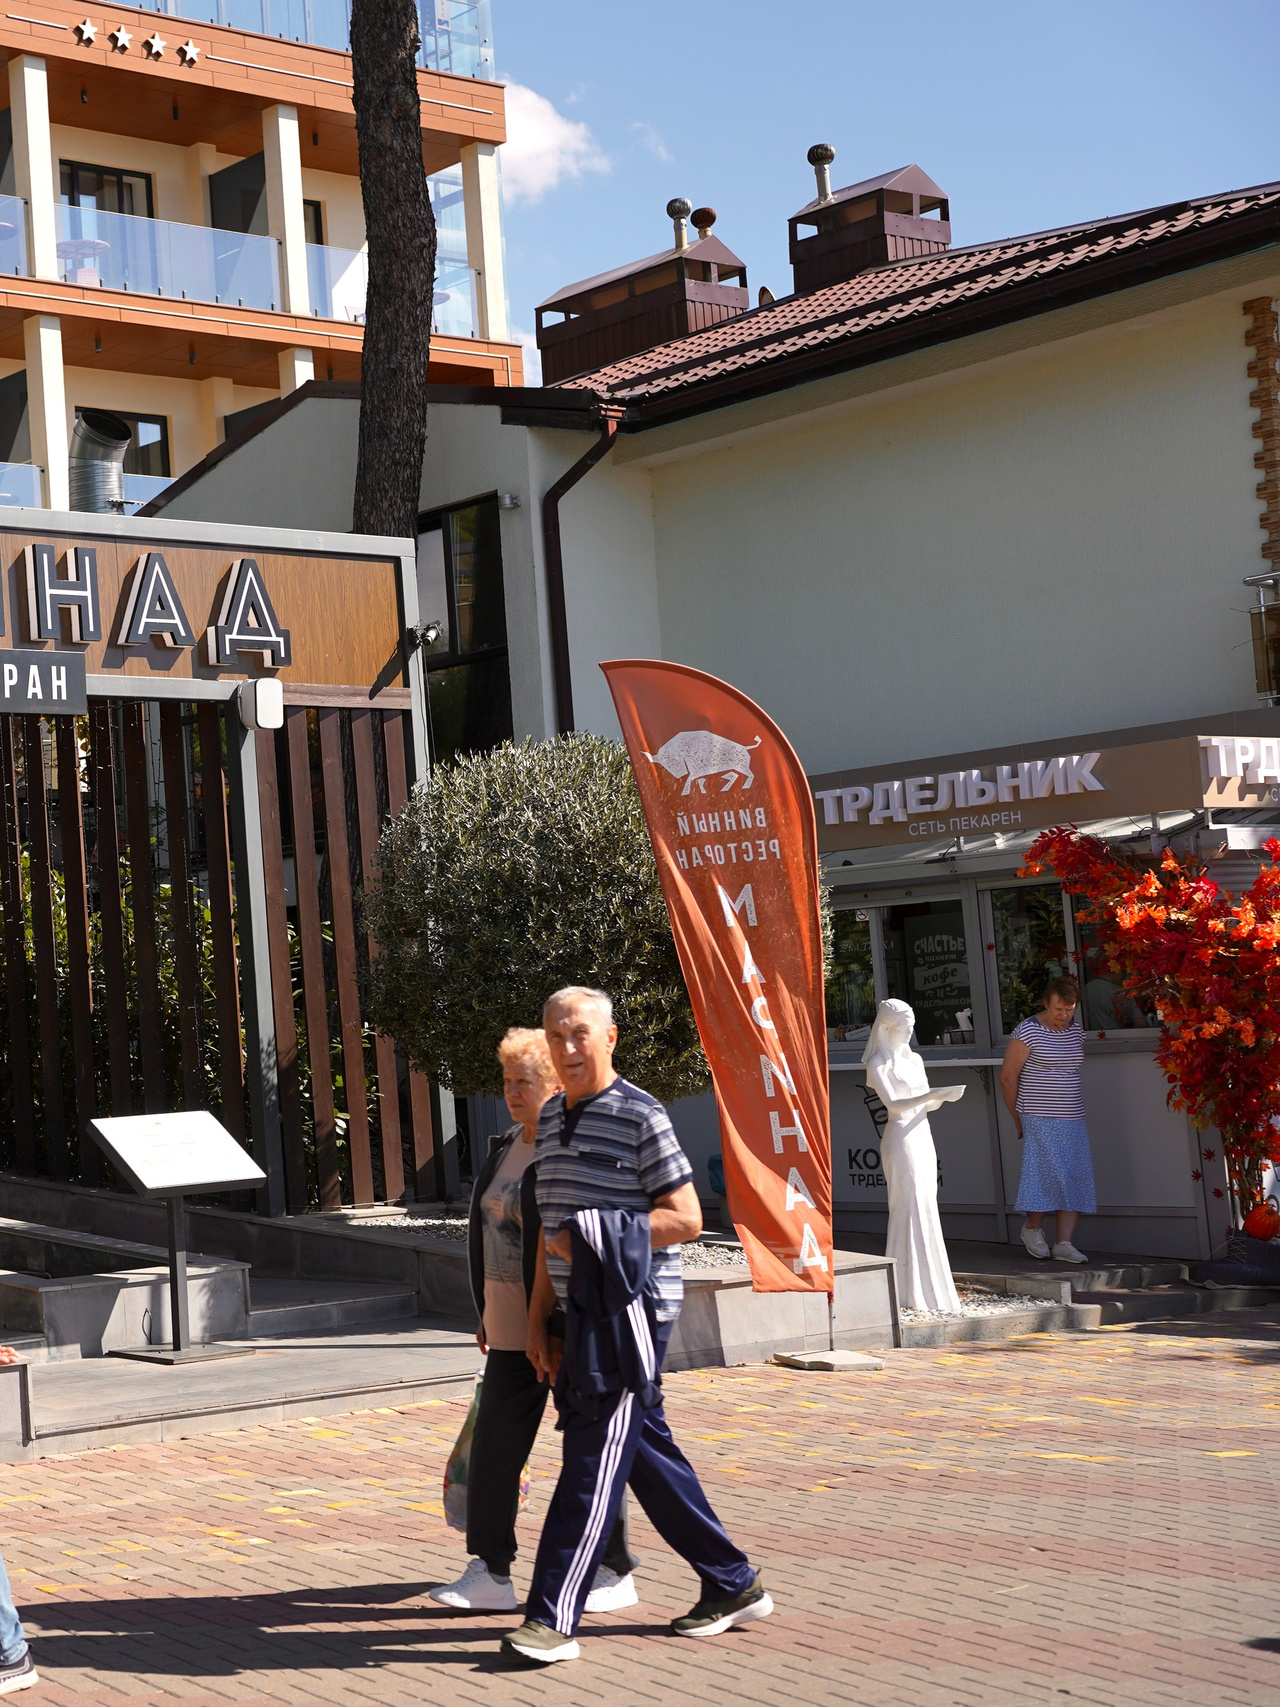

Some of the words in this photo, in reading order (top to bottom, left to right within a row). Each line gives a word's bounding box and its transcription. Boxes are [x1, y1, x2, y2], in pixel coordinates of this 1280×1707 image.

[1200, 738, 1280, 785] ТРД
[815, 752, 1106, 826] ТРДЕЛЬНИК
[908, 820, 946, 836] СЕТЬ
[949, 810, 1022, 832] ПЕКАРЕН
[914, 935, 965, 954] СЧАСТЬЕ
[923, 966, 958, 986] кофе
